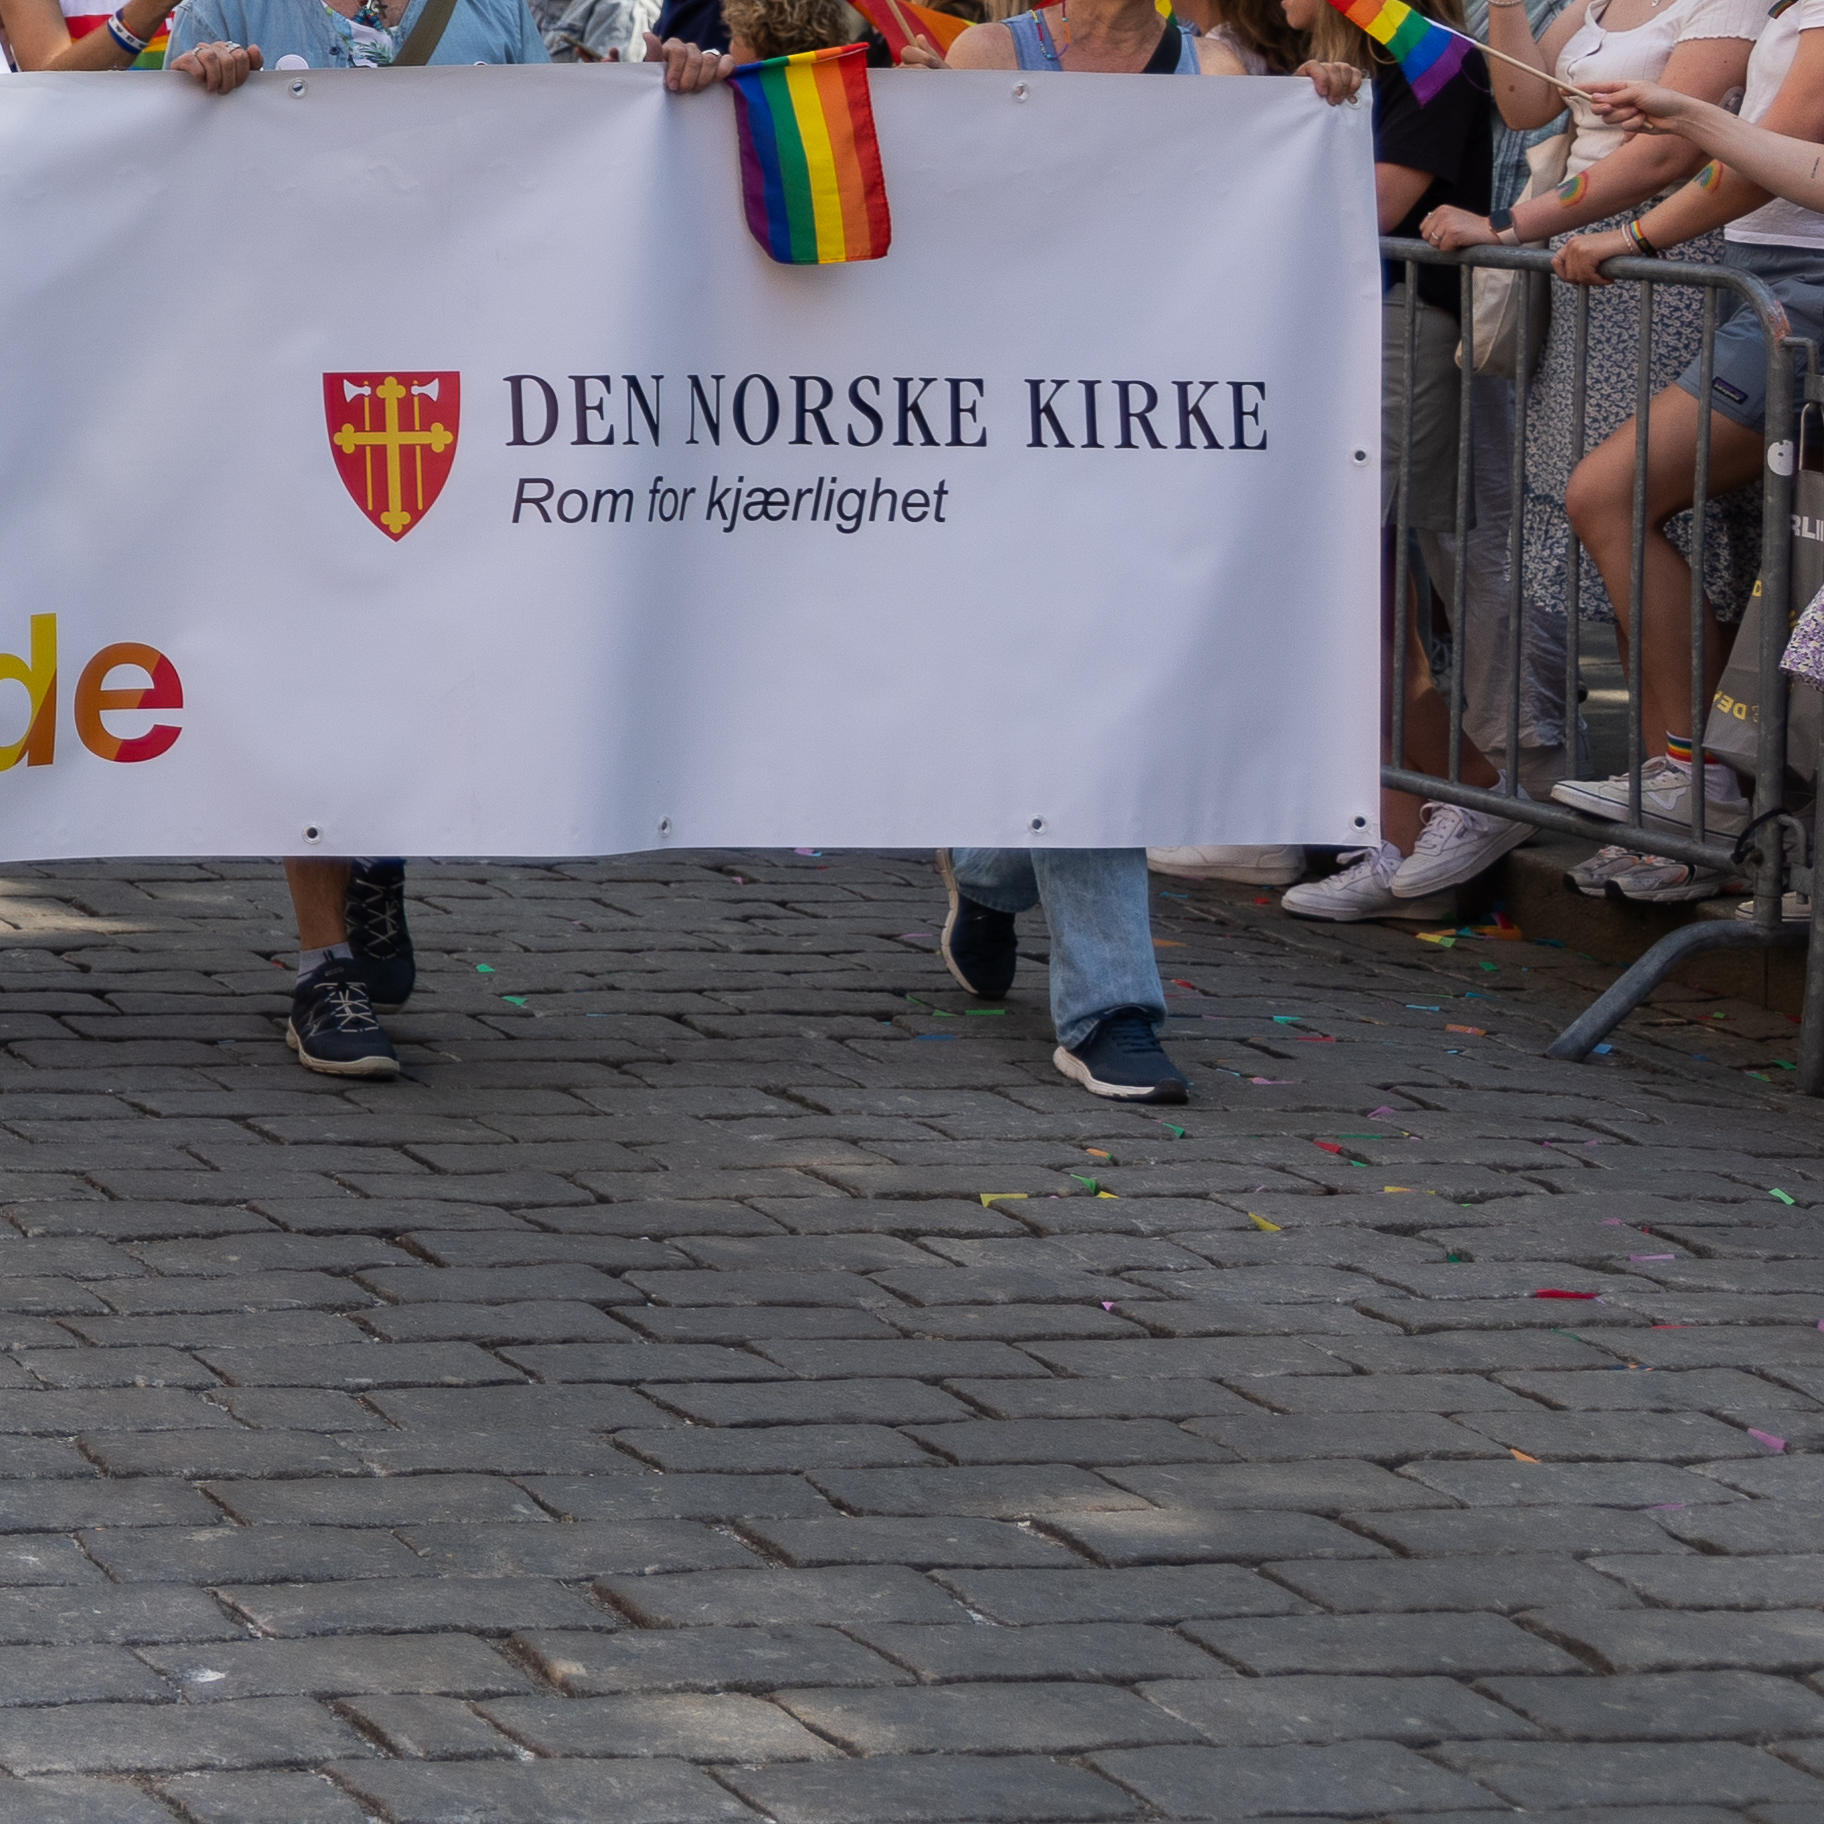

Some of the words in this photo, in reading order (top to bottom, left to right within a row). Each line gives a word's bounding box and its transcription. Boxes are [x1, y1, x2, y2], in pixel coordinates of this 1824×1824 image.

[502, 374, 665, 448] DEN
[684, 373, 988, 448] NORSKE
[1023, 378, 1269, 451] KIRKE
[512, 477, 634, 524] Rom
[647, 475, 697, 523] for
[705, 475, 949, 534] kjærlighet
